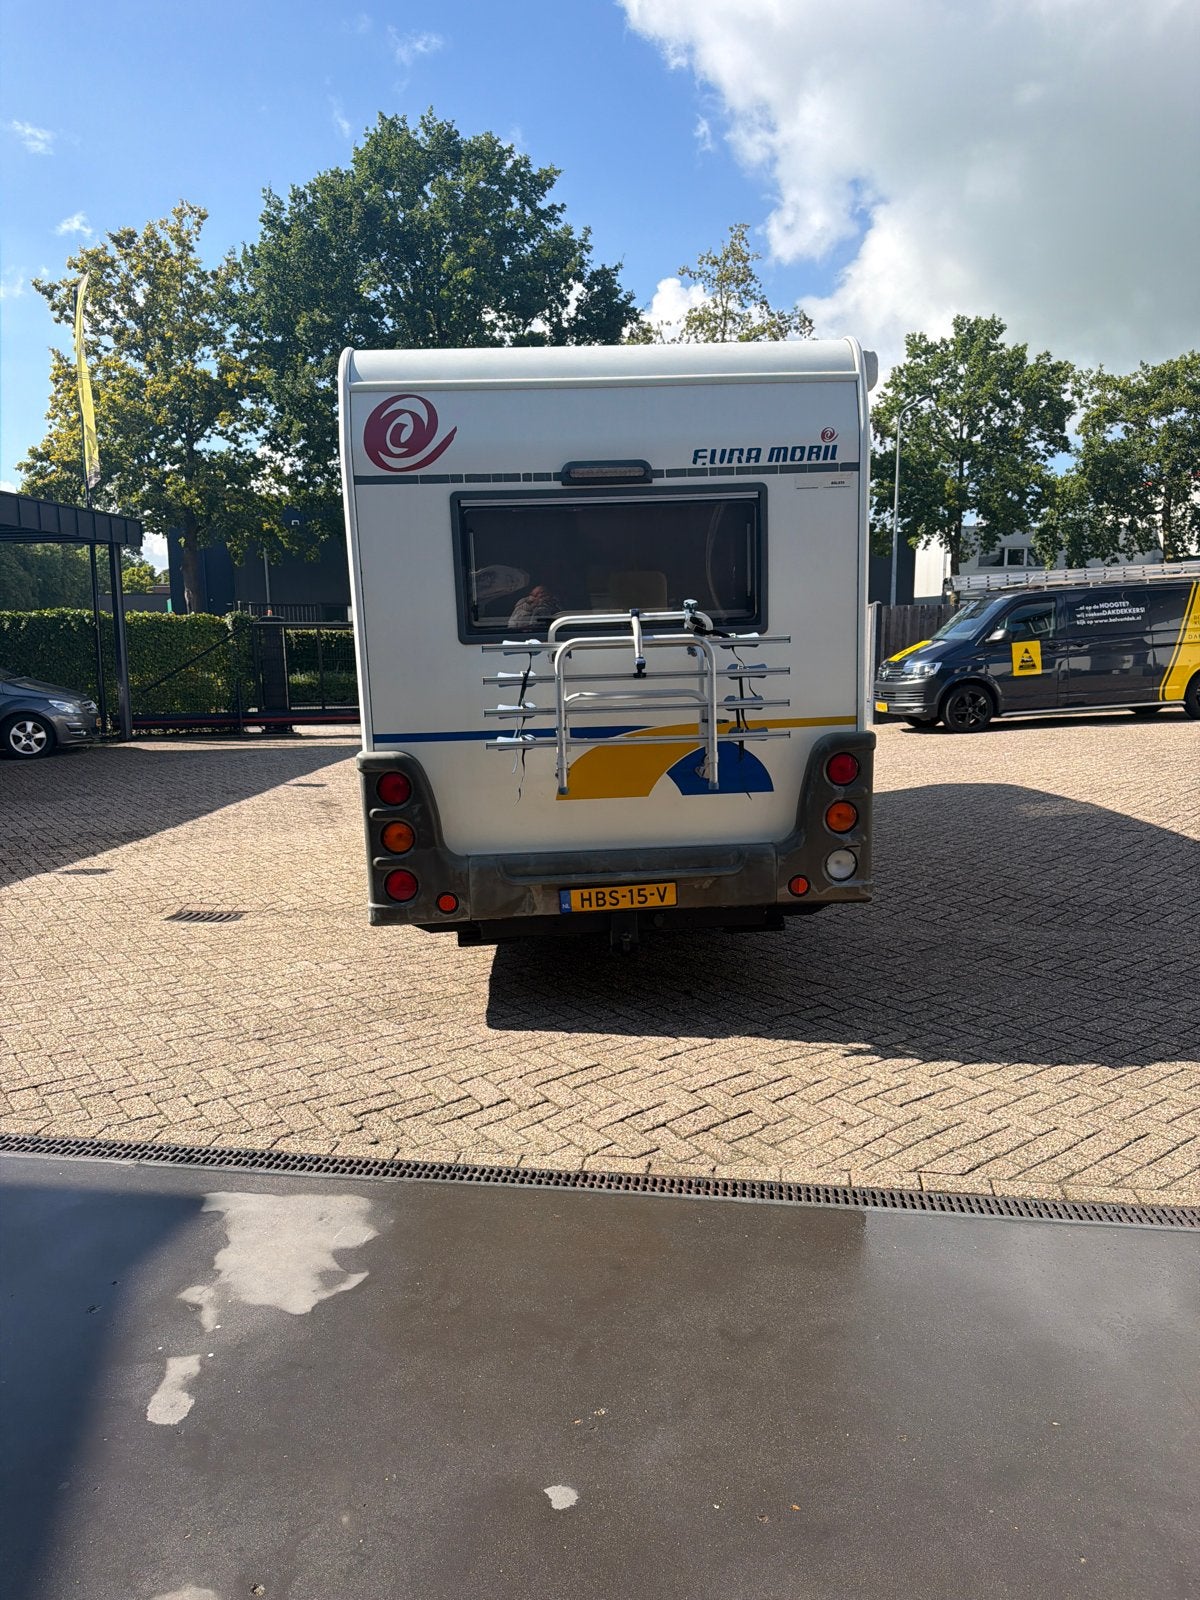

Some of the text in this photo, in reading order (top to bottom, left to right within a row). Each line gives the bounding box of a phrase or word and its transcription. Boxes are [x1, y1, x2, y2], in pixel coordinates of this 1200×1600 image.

[692, 444, 838, 465] EURA MOBIL
[1099, 601, 1130, 609] HOOGTE?
[580, 886, 668, 908] HBS-15-V
